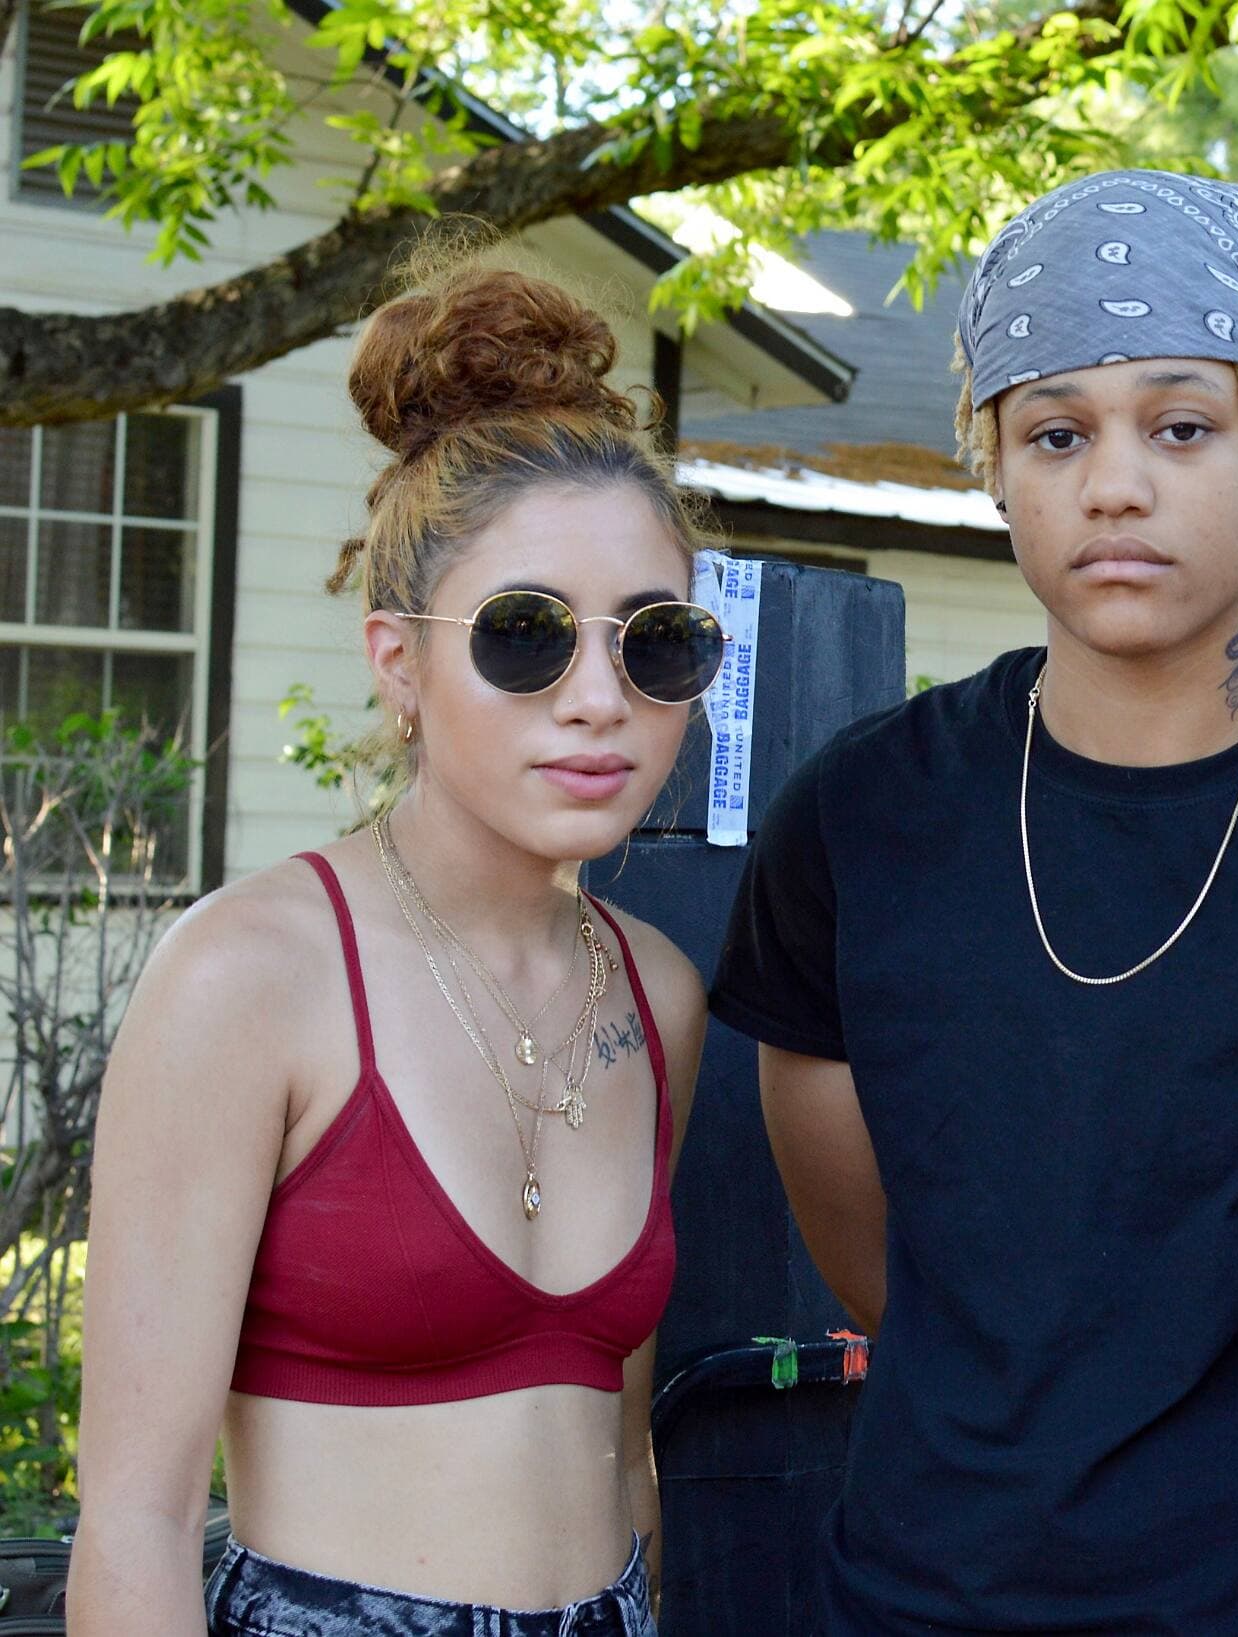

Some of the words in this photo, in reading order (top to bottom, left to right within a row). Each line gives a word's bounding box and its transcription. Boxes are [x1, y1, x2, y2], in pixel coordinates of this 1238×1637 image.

[721, 660, 732, 720] UNITED
[734, 644, 752, 720] BAGGAGE
[712, 732, 731, 809] BAGGAGE
[732, 733, 744, 791] UNITED
